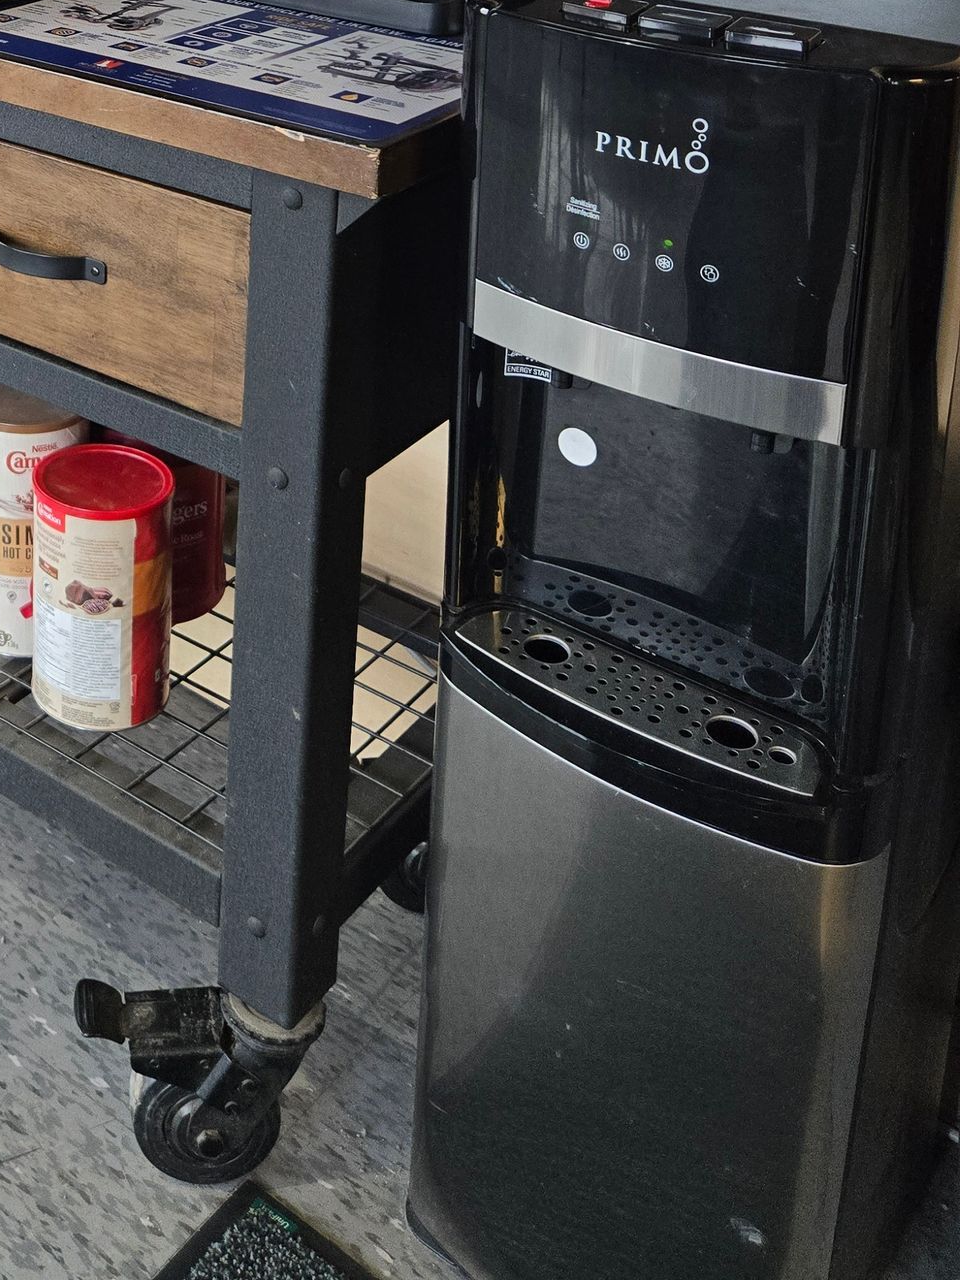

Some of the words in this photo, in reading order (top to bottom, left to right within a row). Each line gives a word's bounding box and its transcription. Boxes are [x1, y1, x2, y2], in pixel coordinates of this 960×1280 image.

[254, 3, 306, 17] VEHICLE
[306, 11, 333, 23] RIDE
[339, 19, 368, 30] LIKE
[415, 36, 464, 48] AGAIN
[595, 124, 710, 174] PRIMO
[569, 196, 598, 211] Sanitizing
[507, 365, 533, 374] ENERGY
[532, 368, 550, 378] STAR
[2, 546, 20, 559] HOT
